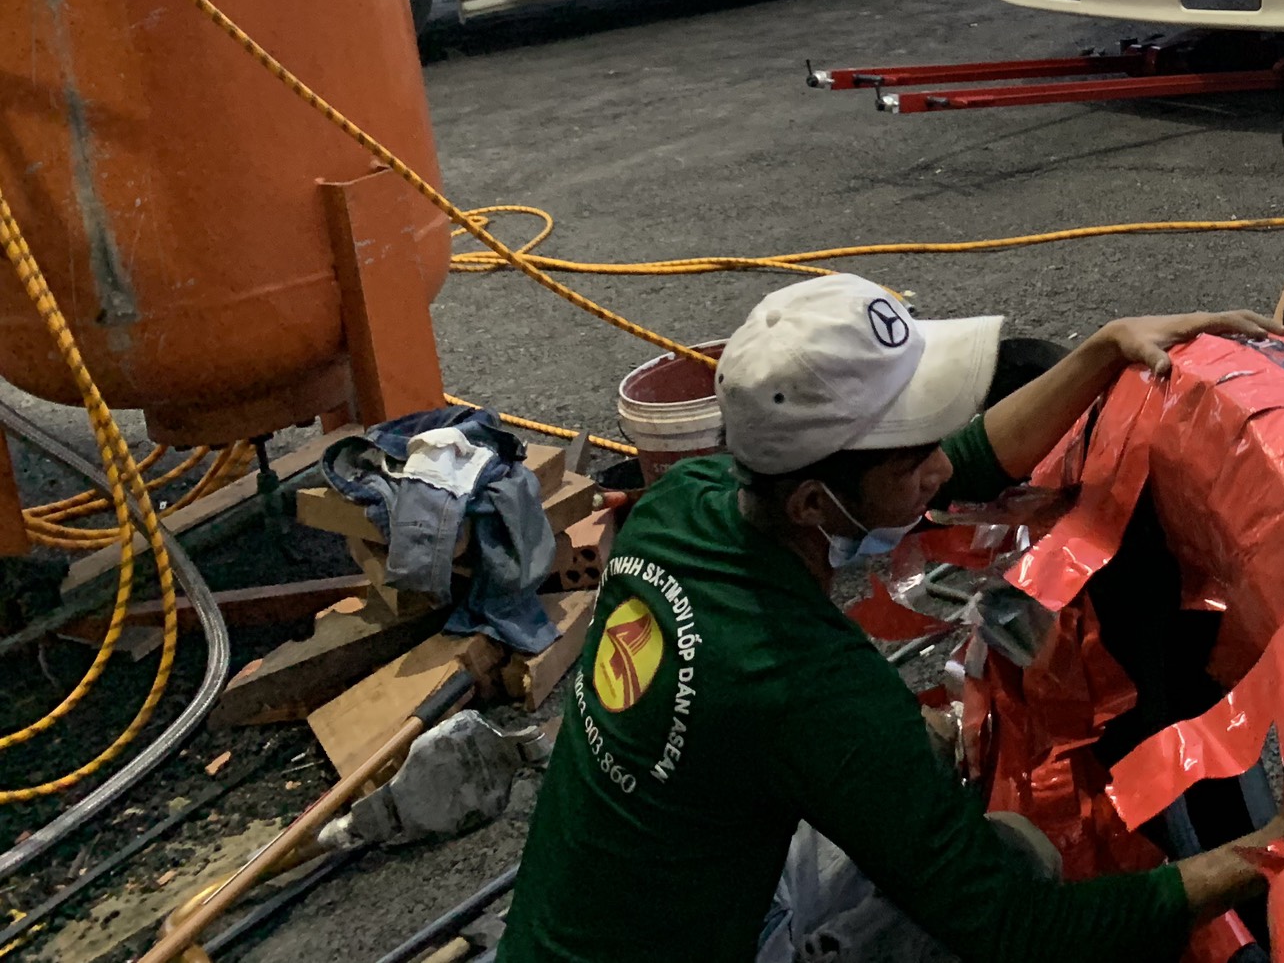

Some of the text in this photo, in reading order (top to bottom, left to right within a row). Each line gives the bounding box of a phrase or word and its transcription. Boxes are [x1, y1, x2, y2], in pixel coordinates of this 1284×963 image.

[609, 557, 644, 576] TNHH
[642, 563, 693, 621] SX-TM-DV
[677, 622, 702, 661] LỐP
[650, 716, 687, 784] ASEAN
